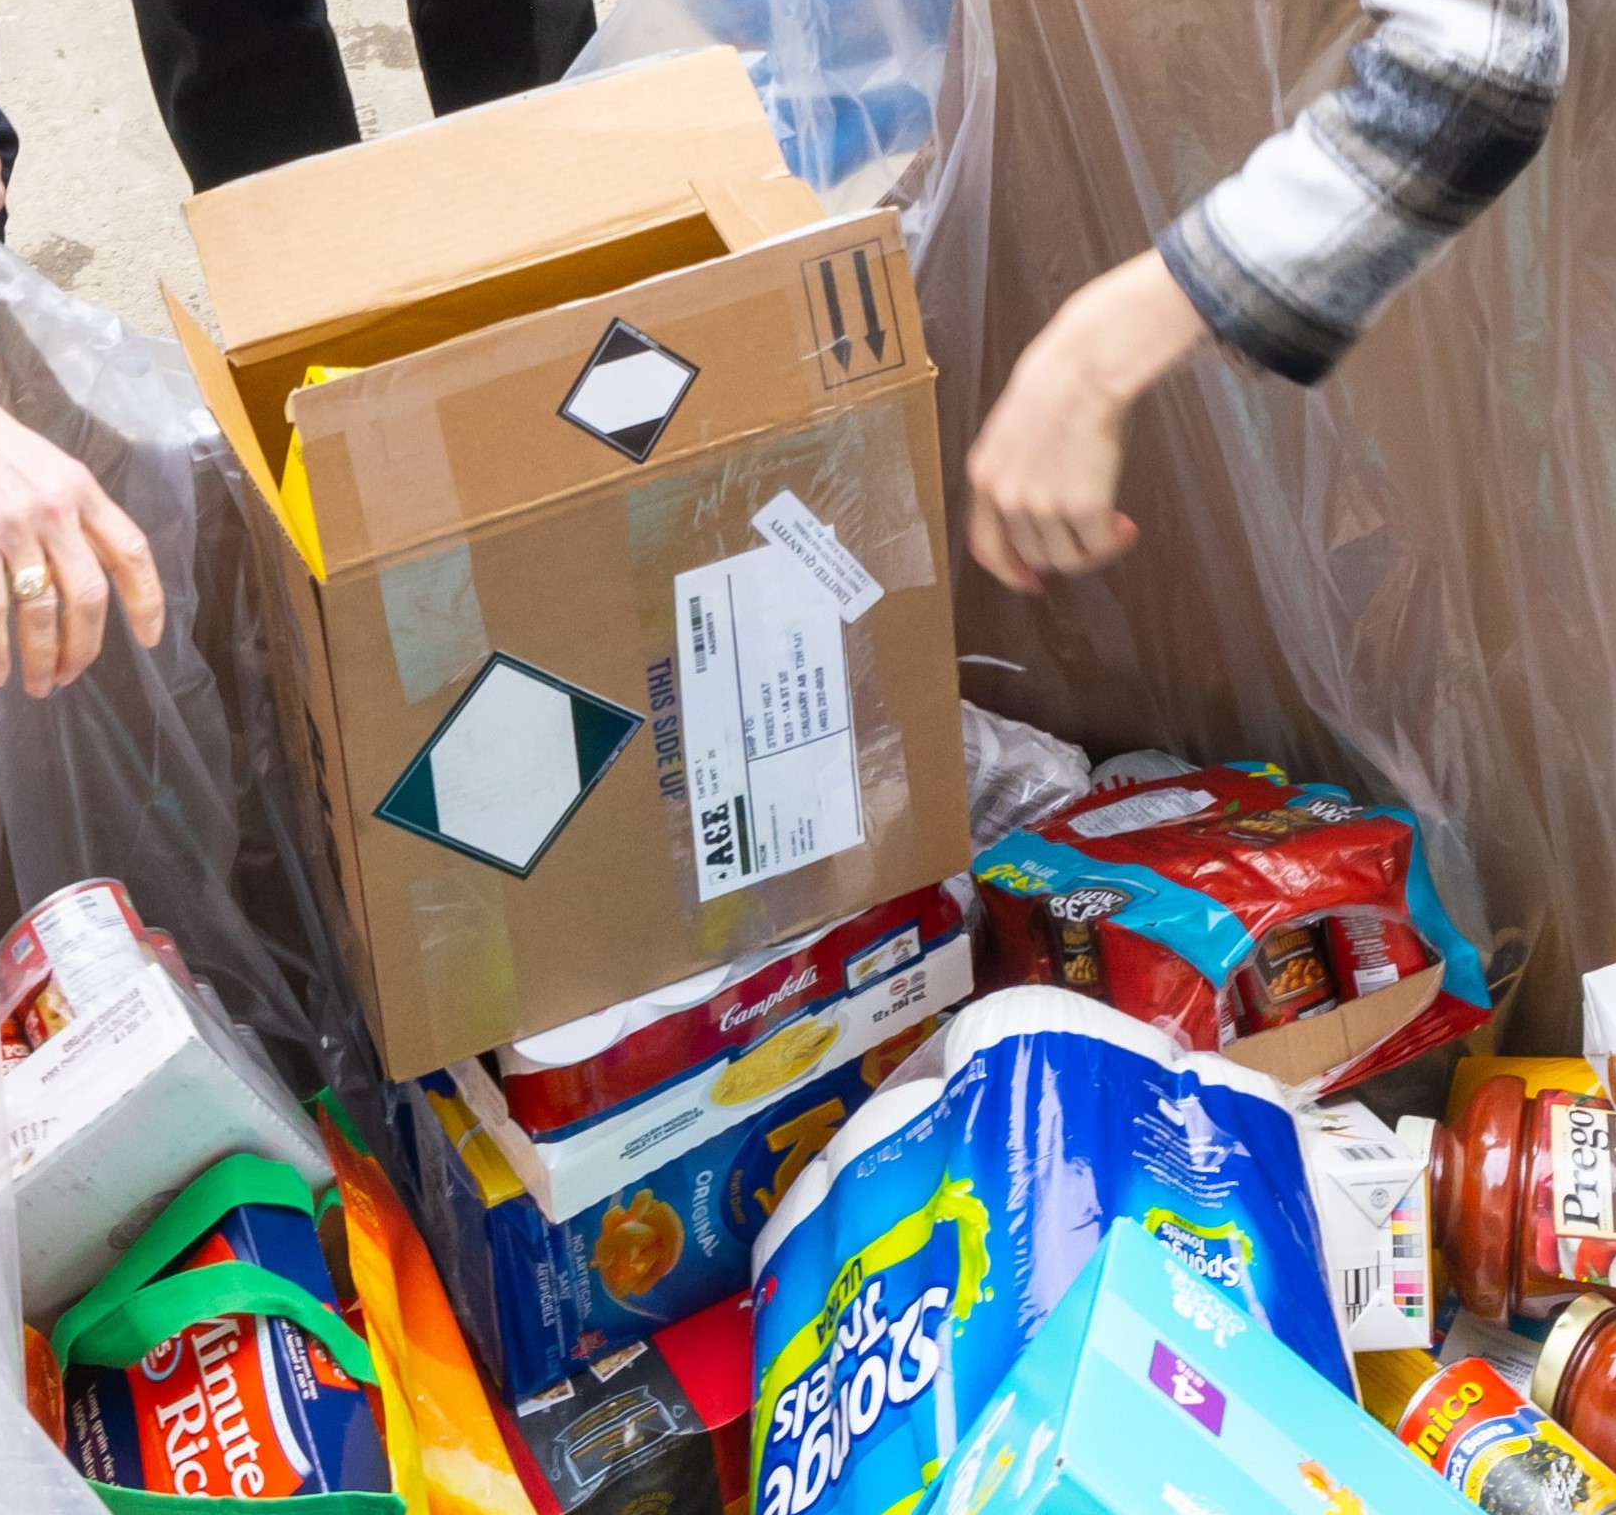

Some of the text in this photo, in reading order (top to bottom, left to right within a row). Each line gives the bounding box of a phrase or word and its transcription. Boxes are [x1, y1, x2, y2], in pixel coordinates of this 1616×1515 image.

[770, 518, 823, 569] QUANTITY
[812, 559, 853, 608] LIMITED
[647, 657, 685, 799] THIS SIDE UP
[760, 681, 778, 749] STREET HEAT
[800, 689, 813, 737] CALGARY
[747, 735, 758, 758] SHIP
[701, 799, 736, 867] ACE
[718, 964, 819, 1034] Campbell's
[1562, 1108, 1610, 1232] Prego
[691, 1170, 720, 1259] ORIGINAL
[1162, 1222, 1210, 1257] Towels
[536, 1262, 555, 1328] ARTIFICIELS
[576, 1254, 594, 1318] ARTIFICIAL
[1461, 1421, 1515, 1456] Beans
